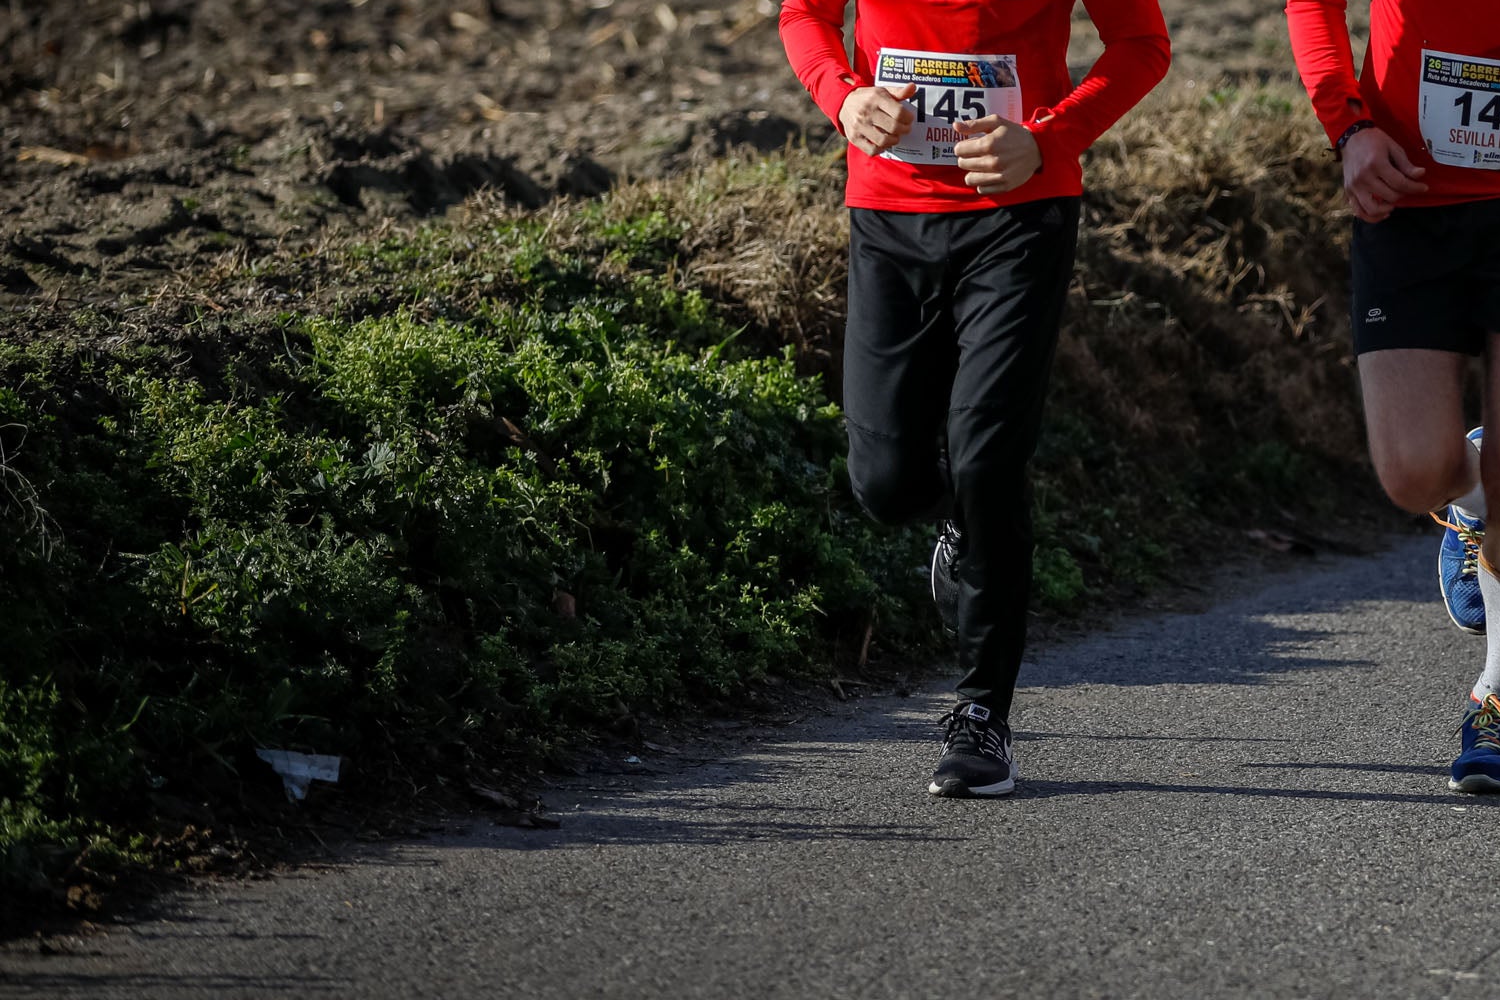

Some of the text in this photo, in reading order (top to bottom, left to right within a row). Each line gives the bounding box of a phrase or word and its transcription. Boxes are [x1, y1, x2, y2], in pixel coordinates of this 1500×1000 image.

[904, 58, 914, 73] VII
[914, 59, 964, 70] CARRERA
[1428, 58, 1441, 69] 26
[1451, 61, 1462, 77] VII
[882, 71, 894, 79] Ruta
[902, 73, 911, 81] los
[911, 75, 941, 83] Secaderos
[914, 67, 964, 77] POPULAR
[1427, 72, 1440, 81] Ruta
[1449, 76, 1458, 84] los
[1459, 78, 1490, 88] Secaderos
[909, 87, 986, 124] 145
[1449, 128, 1495, 149] SEVILLA
